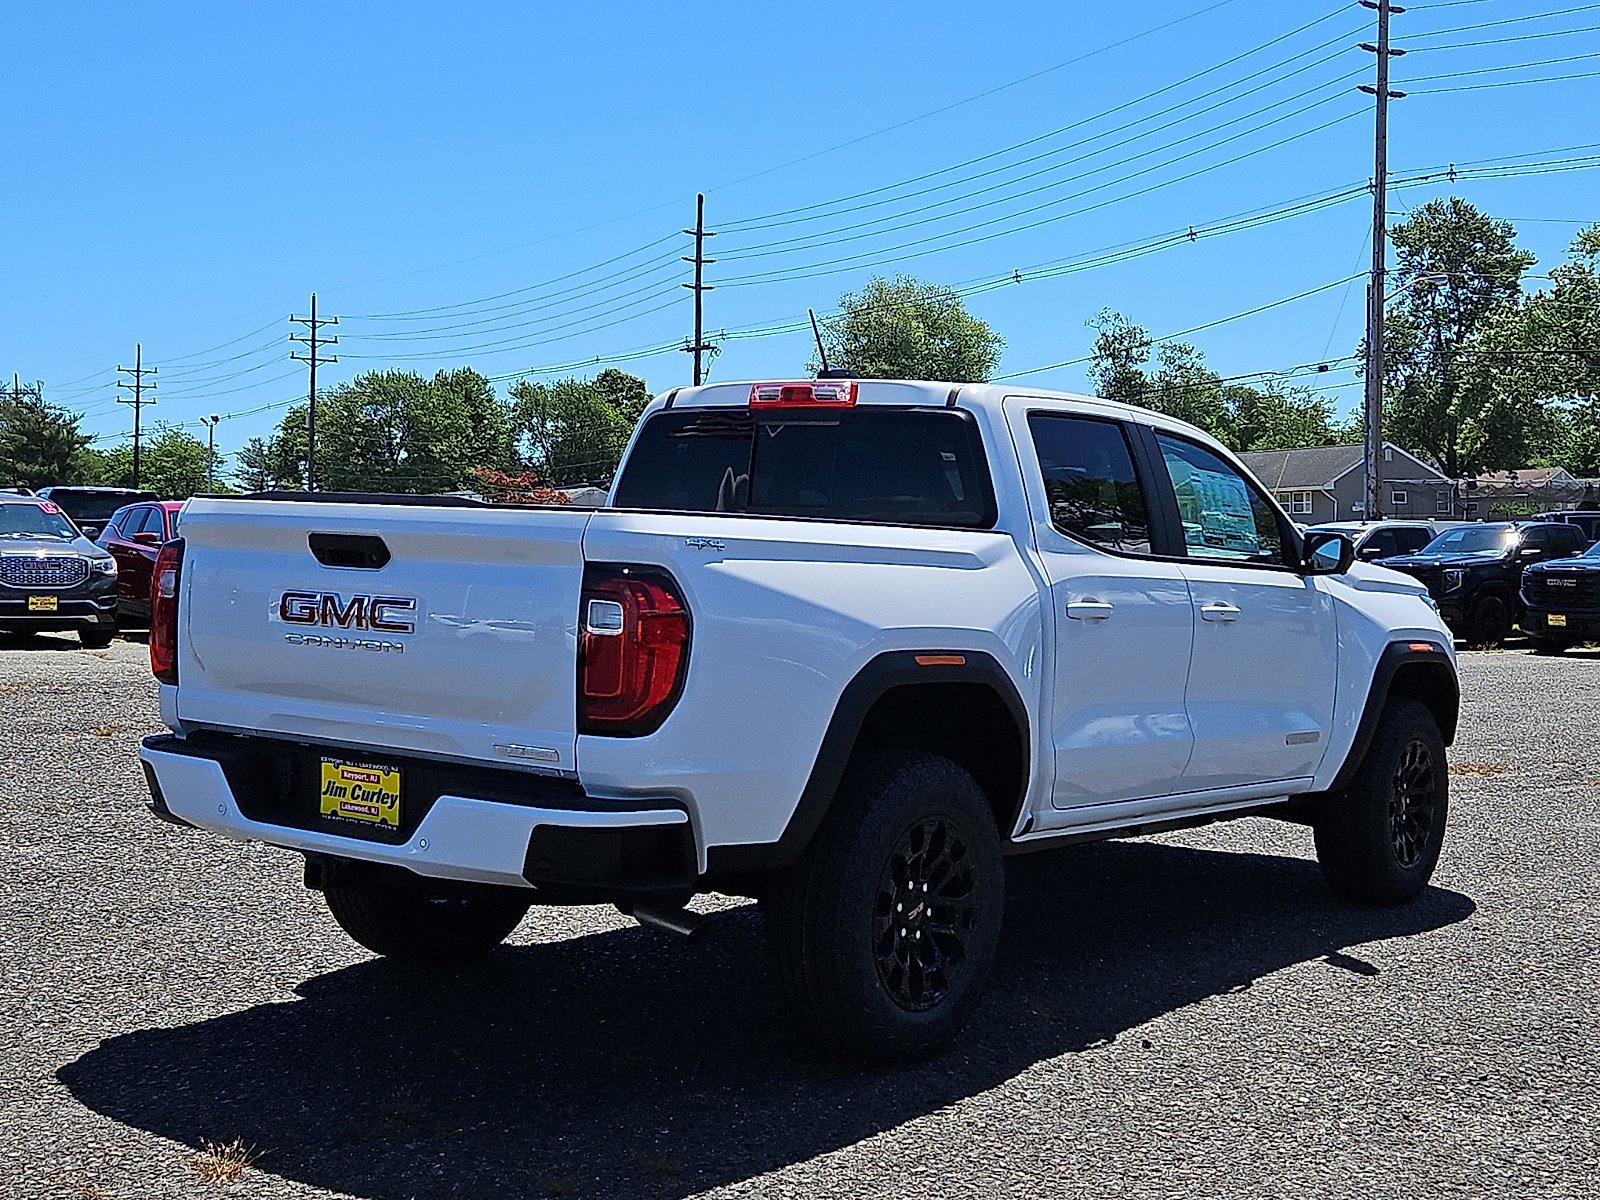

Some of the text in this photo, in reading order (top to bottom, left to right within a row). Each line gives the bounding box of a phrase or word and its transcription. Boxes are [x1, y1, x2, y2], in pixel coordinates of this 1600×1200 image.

[23, 561, 59, 569] GMC
[279, 589, 417, 635] GMC
[284, 633, 404, 654] CANYON
[343, 771, 369, 781] Keyport,
[322, 780, 398, 810] Jim Curley
[341, 802, 378, 815] Lakewood, NJ
